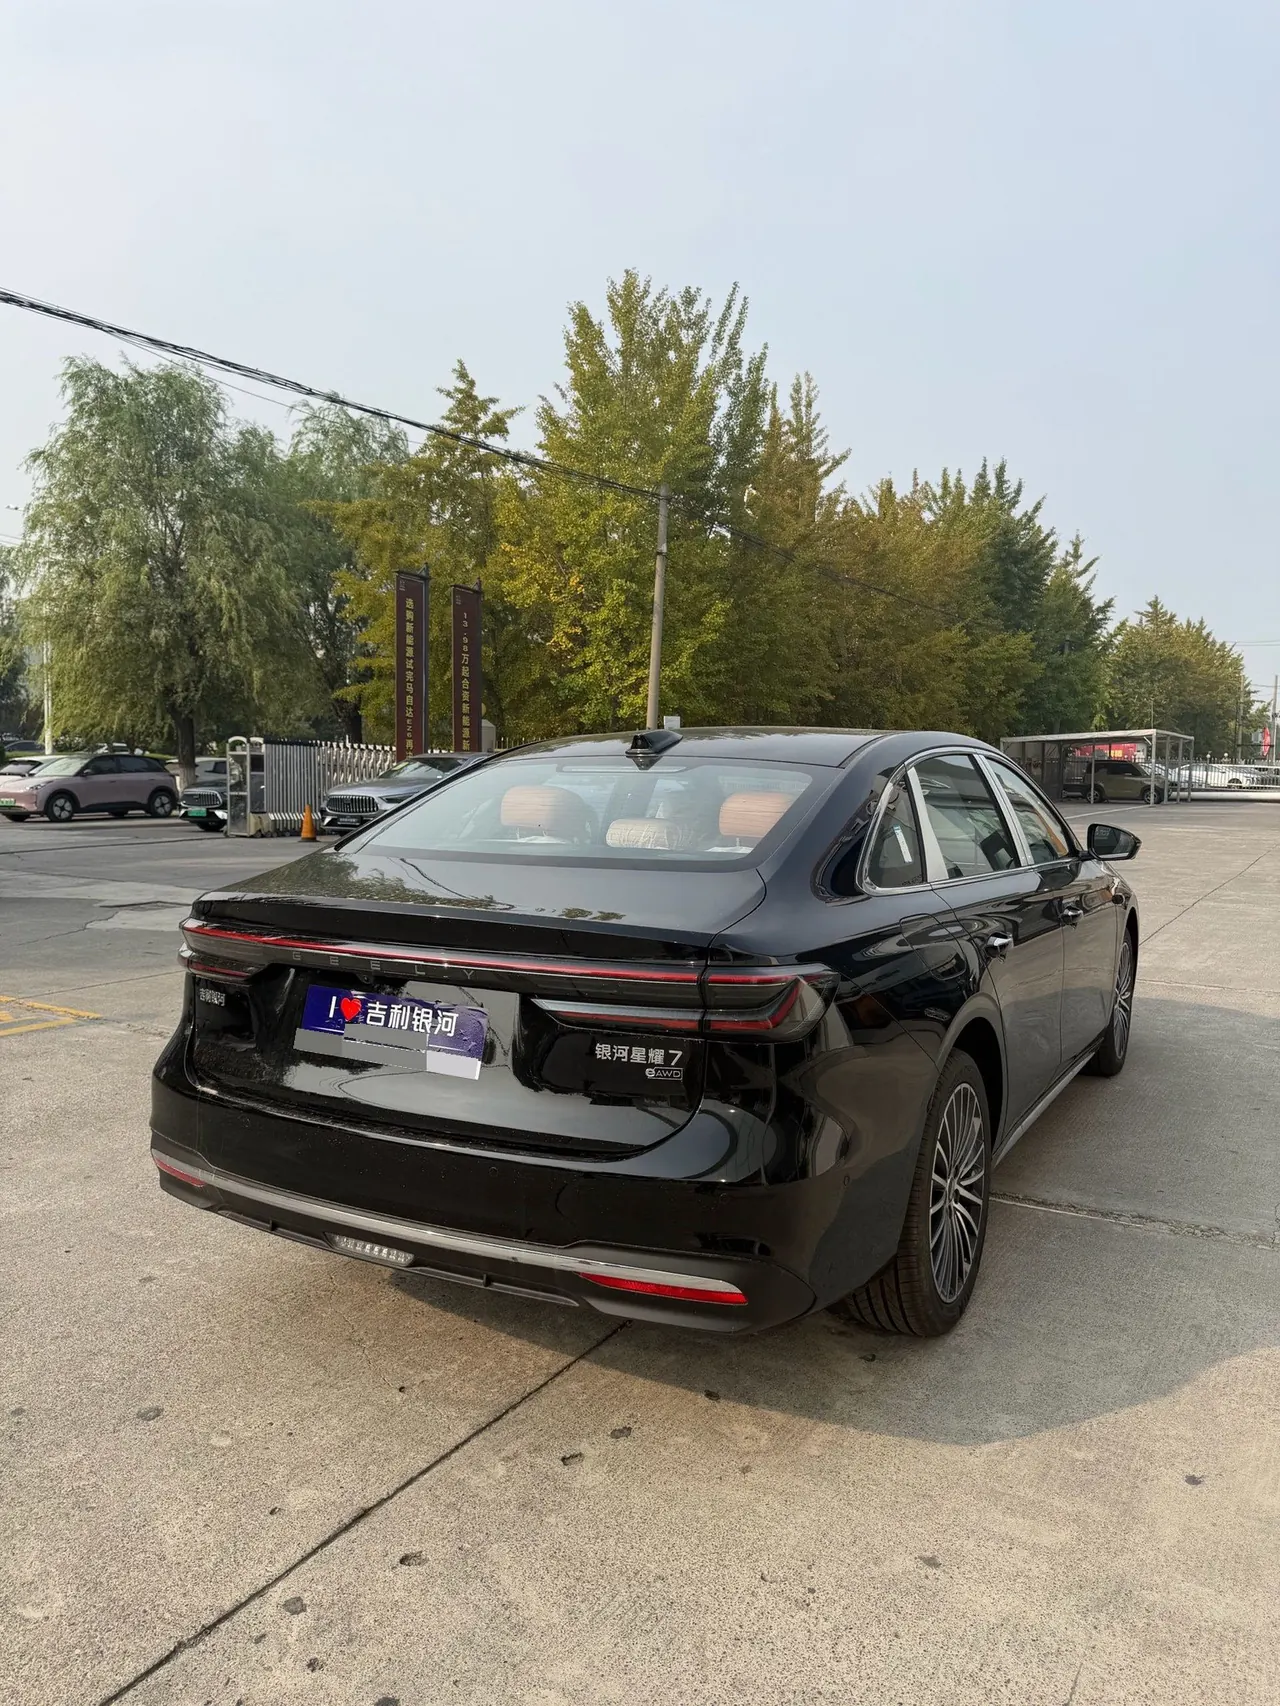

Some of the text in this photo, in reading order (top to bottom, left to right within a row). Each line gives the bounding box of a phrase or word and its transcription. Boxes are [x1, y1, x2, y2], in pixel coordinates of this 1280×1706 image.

[292, 951, 475, 980] GEELY
[365, 1000, 460, 1038] 吉利银河
